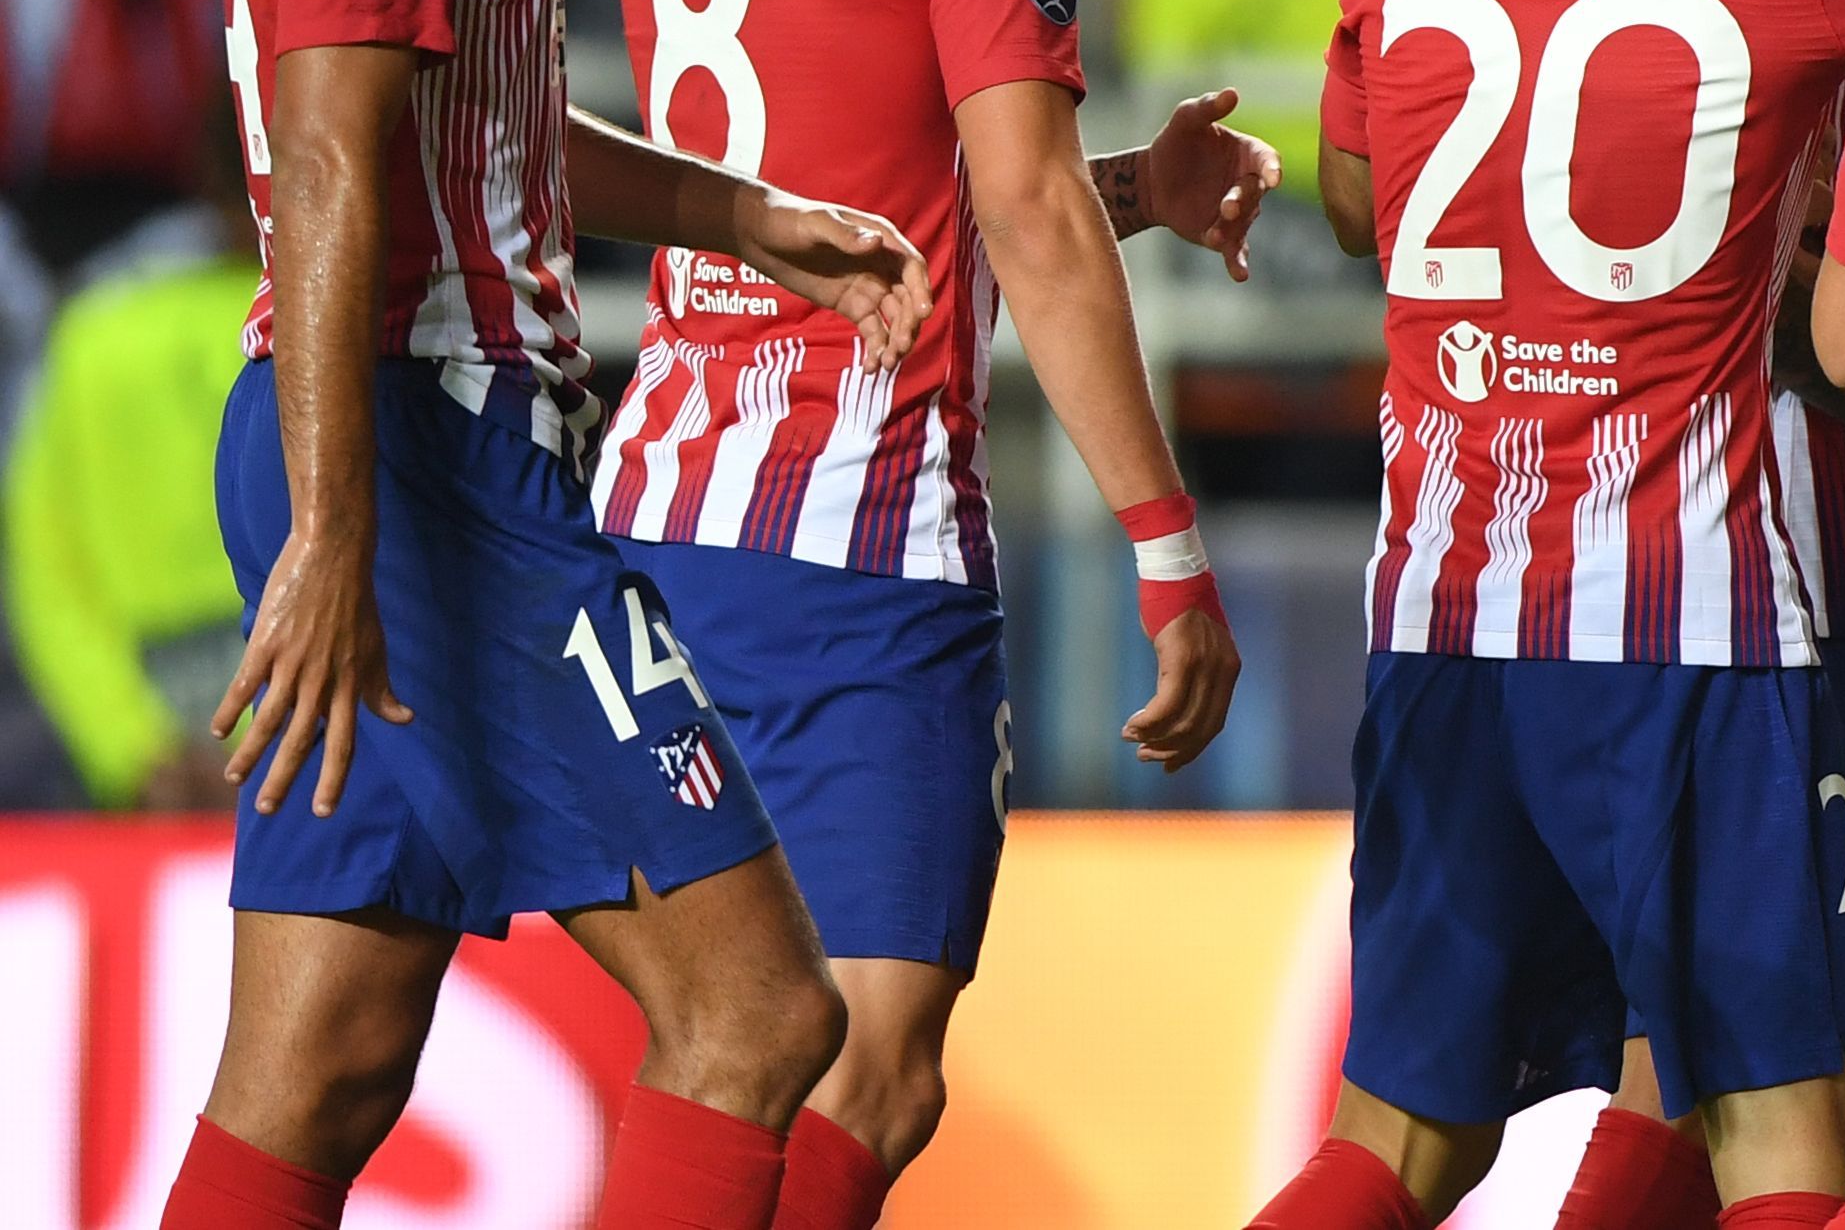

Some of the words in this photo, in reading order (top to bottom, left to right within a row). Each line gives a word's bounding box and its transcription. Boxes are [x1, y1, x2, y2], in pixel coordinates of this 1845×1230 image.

[693, 256, 736, 284] Save
[690, 286, 779, 317] Children
[1501, 334, 1564, 362] Save
[1569, 338, 1618, 364] the
[1503, 366, 1619, 396] Children
[562, 587, 709, 743] 14
